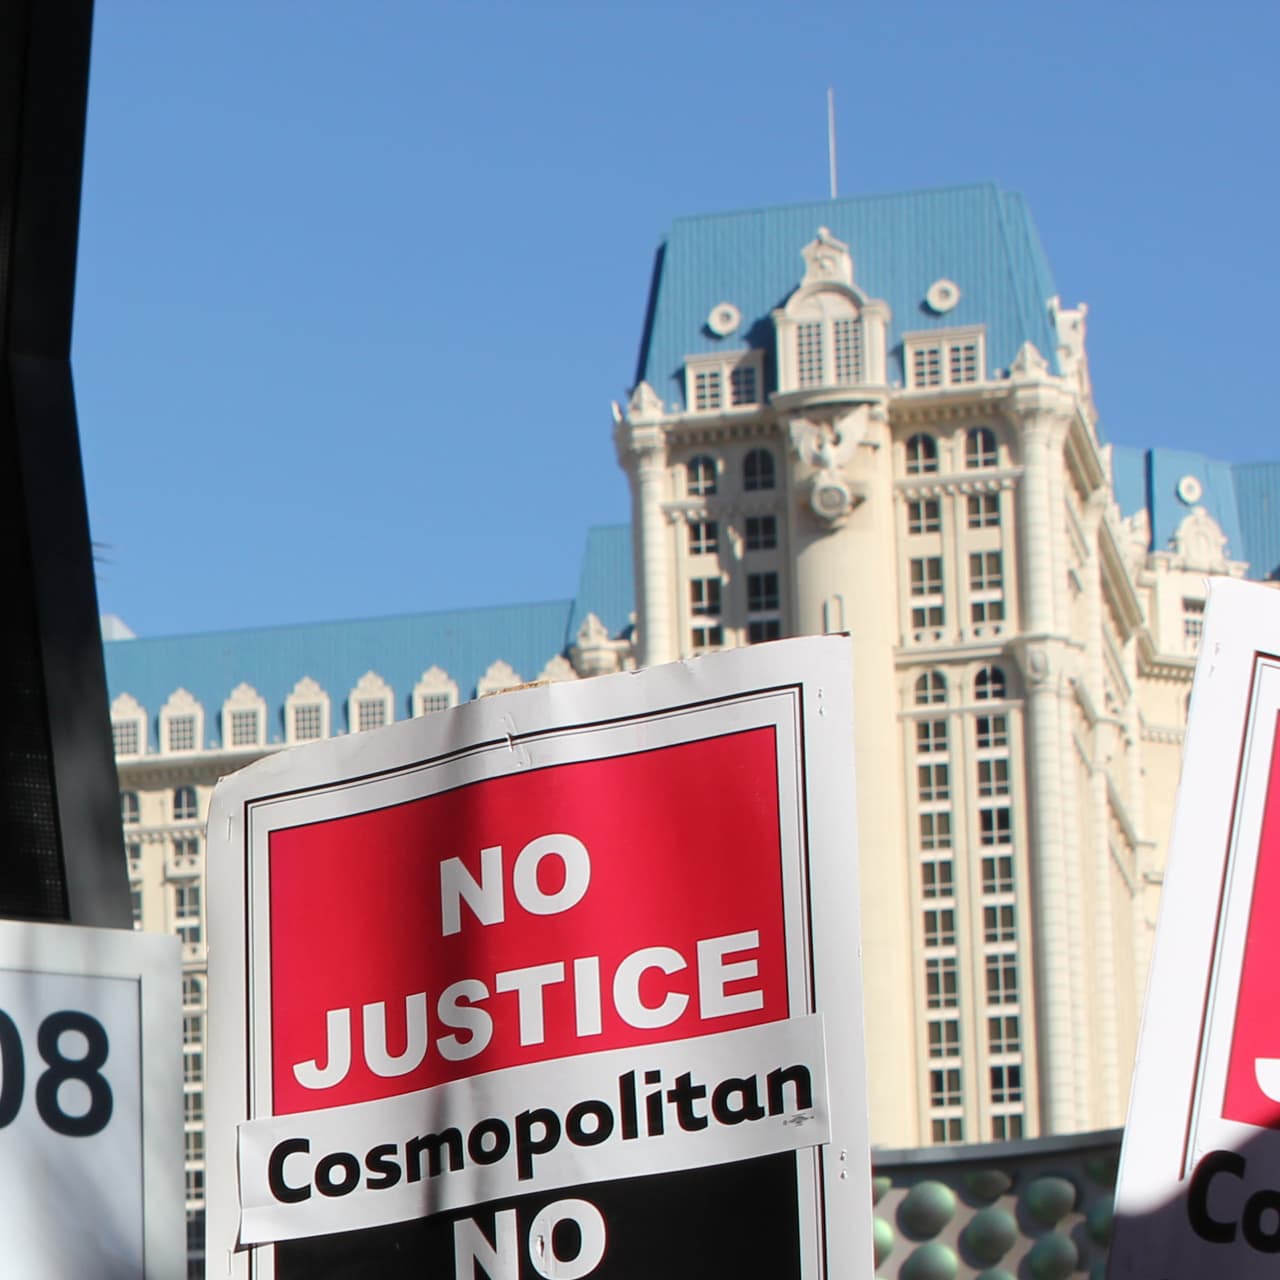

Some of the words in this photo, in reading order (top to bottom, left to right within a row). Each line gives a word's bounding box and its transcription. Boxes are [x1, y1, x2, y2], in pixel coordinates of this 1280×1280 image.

[440, 833, 591, 936] NO
[292, 930, 764, 1090] JUSTICE
[267, 1063, 812, 1204] Cosmopolitan
